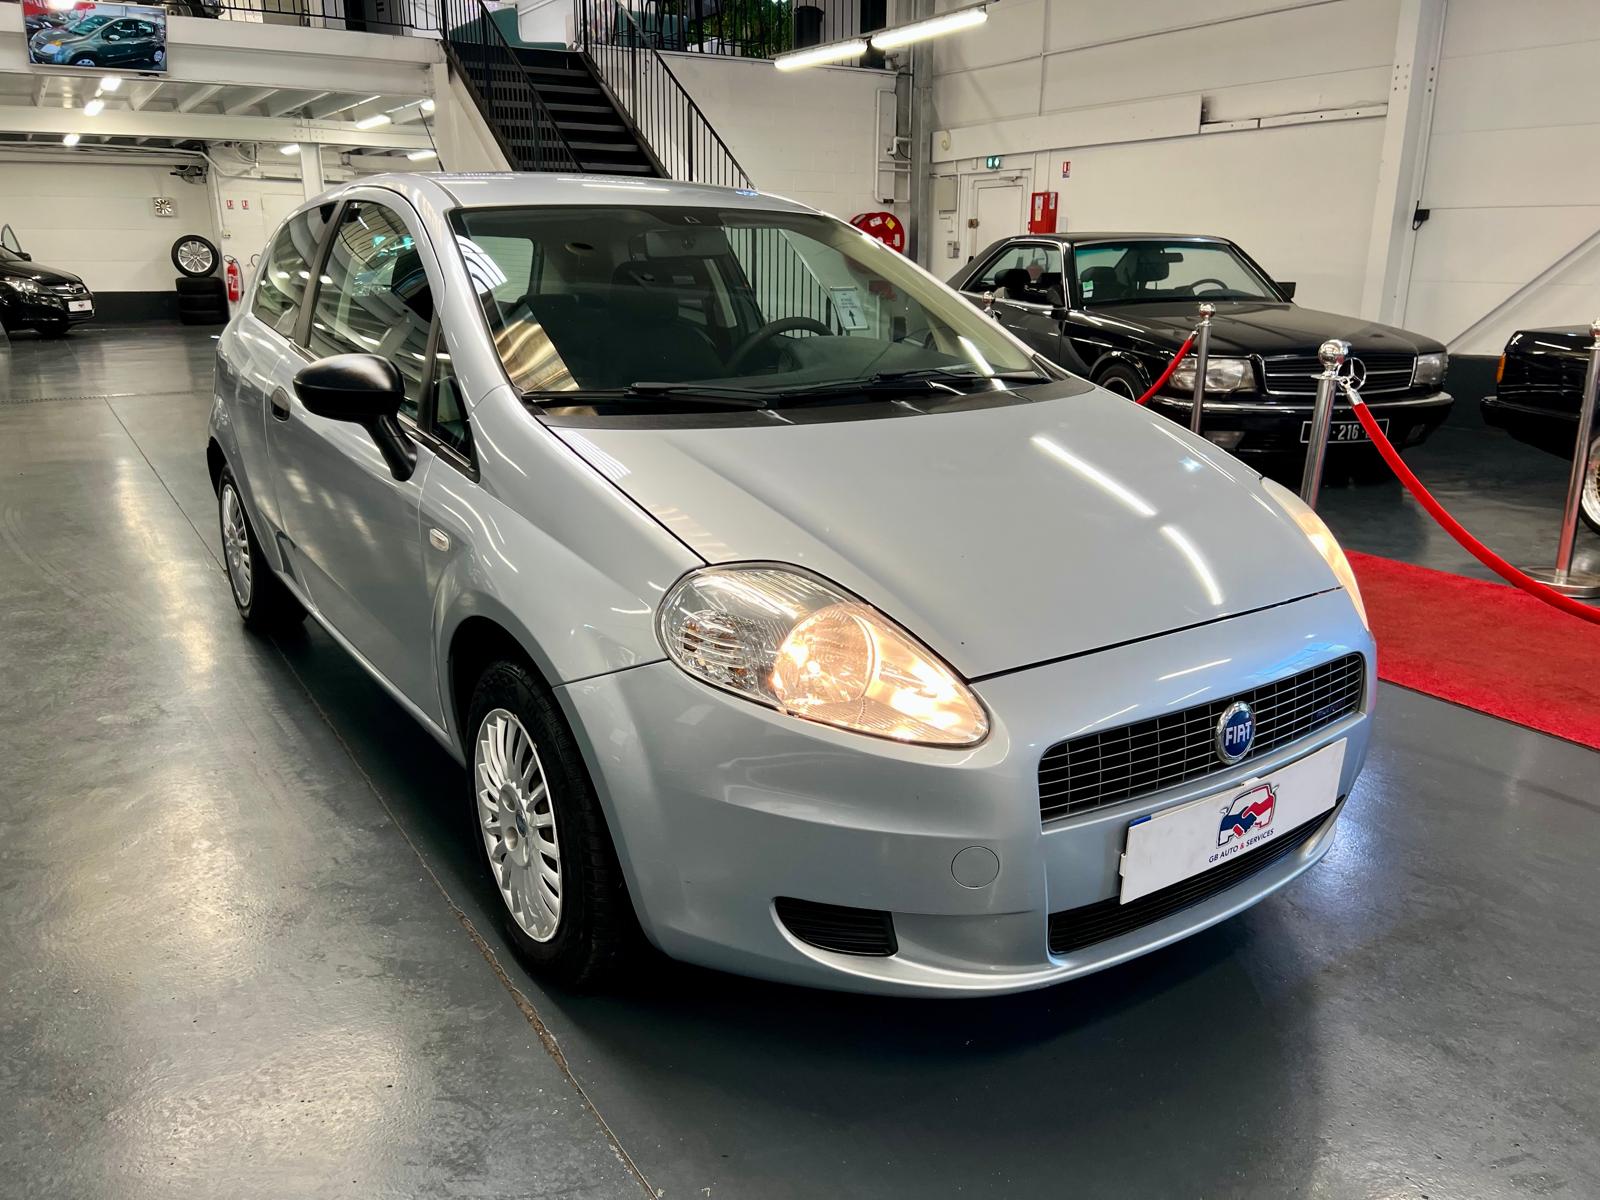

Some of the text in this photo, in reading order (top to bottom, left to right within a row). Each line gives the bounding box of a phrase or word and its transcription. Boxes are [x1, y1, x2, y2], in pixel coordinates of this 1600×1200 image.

[1225, 721, 1252, 746] FIAT
[1209, 828, 1274, 863] GB AUTO & SERVICES
